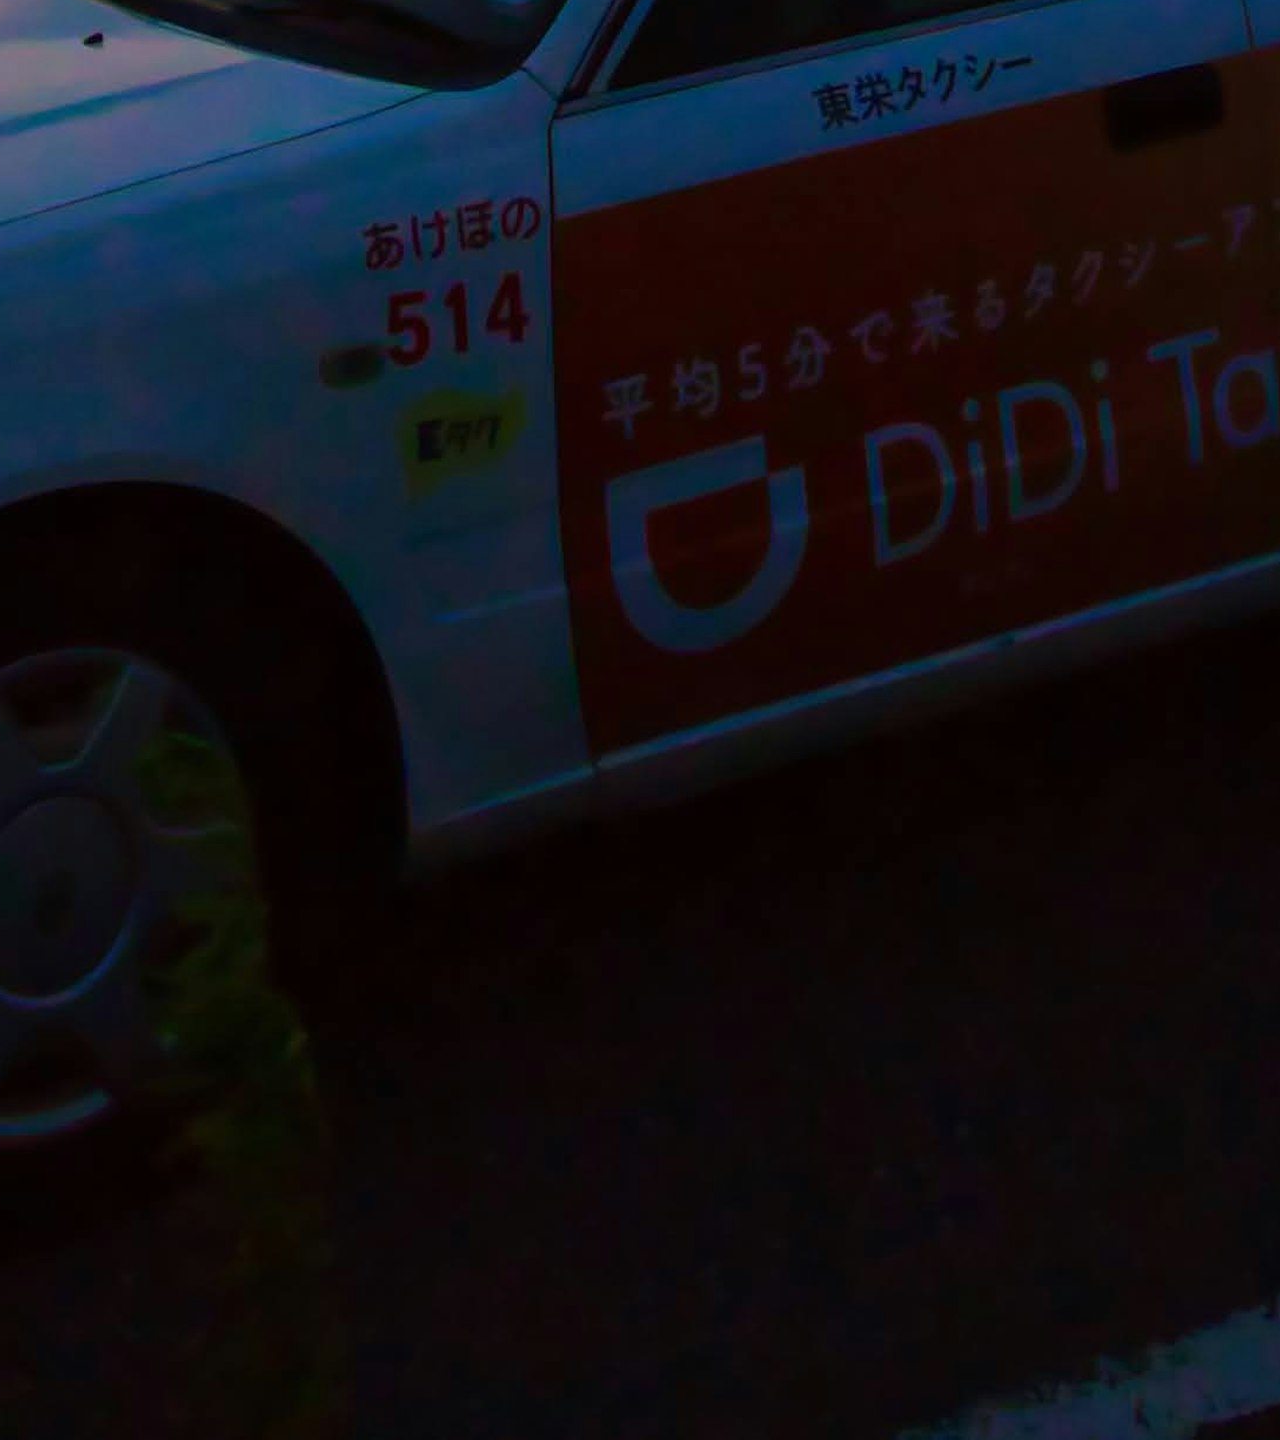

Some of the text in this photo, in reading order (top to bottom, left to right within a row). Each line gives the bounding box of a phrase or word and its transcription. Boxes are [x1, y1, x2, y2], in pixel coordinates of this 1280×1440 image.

[812, 51, 1033, 131] 東栄タクシー
[363, 196, 539, 271] あけぼの
[384, 274, 529, 366] 514
[865, 360, 1120, 567] DiDi
